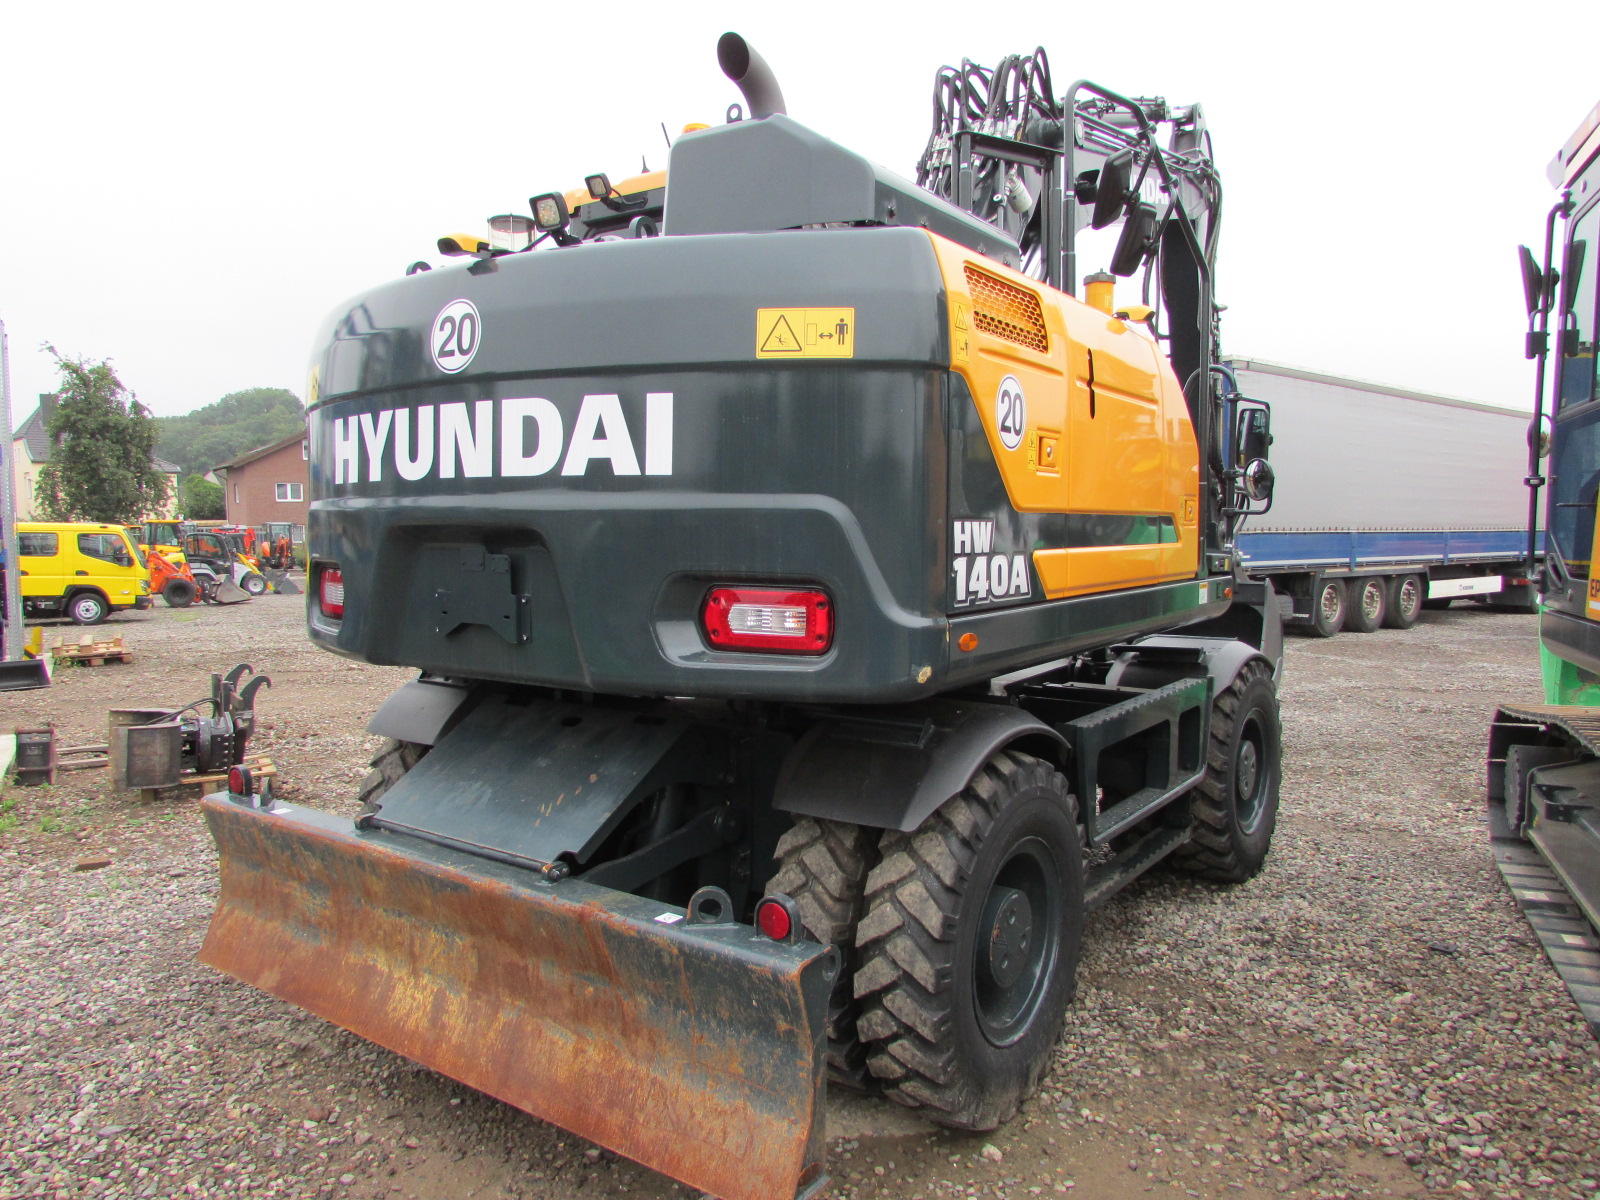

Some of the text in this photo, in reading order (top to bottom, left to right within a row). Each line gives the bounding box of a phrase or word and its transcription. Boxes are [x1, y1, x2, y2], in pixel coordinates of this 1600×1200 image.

[438, 312, 477, 358] 20
[1000, 389, 1023, 436] 20
[334, 392, 674, 485] HYUNDAI
[953, 521, 993, 554] HW
[952, 554, 1029, 601] 140A
